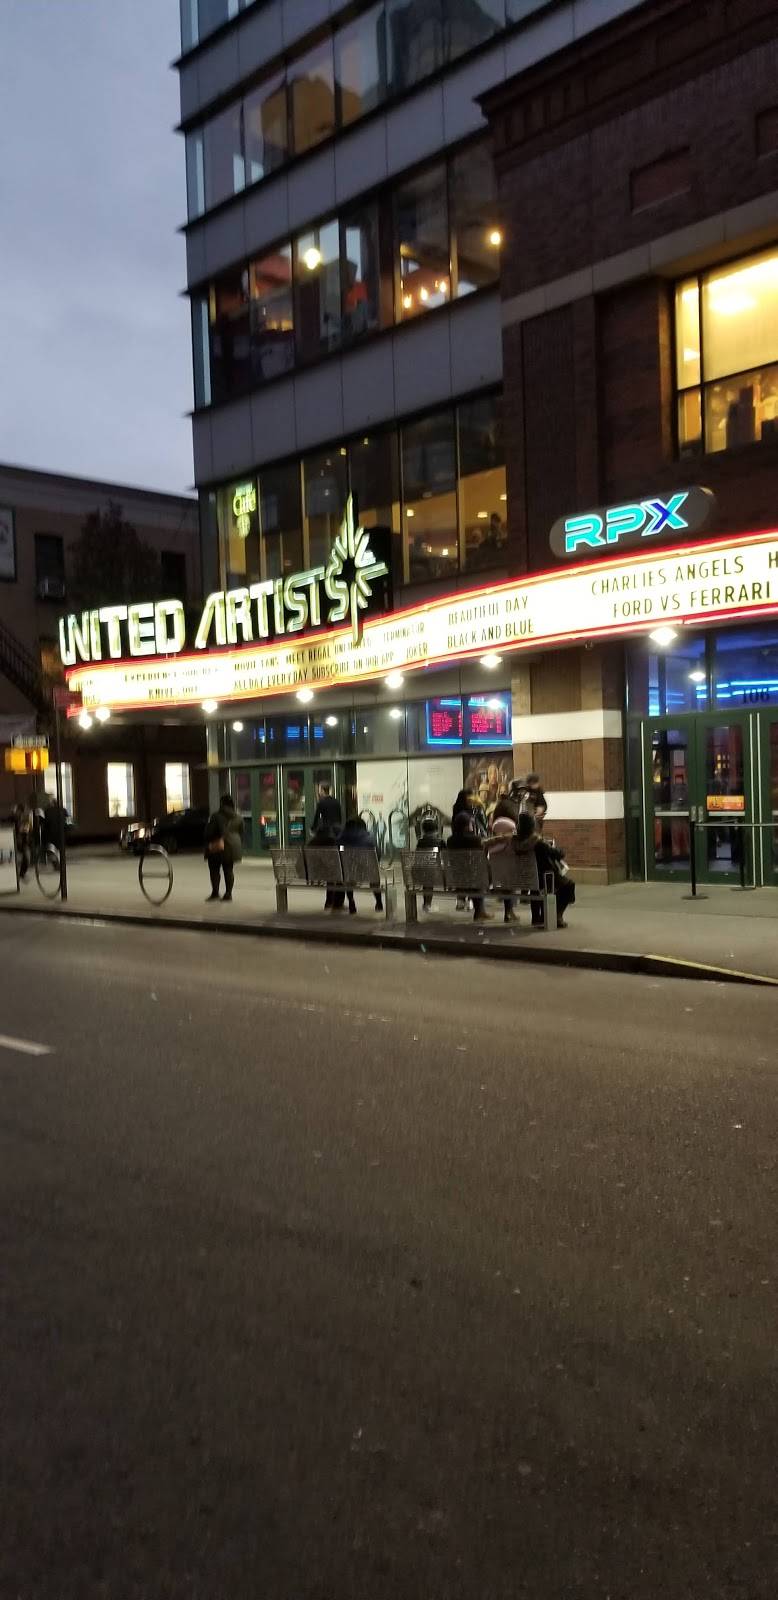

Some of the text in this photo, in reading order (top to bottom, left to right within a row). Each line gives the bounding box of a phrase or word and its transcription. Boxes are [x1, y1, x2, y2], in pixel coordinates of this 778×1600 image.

[564, 492, 689, 553] RPX
[591, 568, 667, 596] CHARLIES
[674, 556, 745, 583] ANGELS
[59, 550, 350, 666] UNITED ARTISTS
[447, 595, 528, 626] BEAUTIFUL DAY
[612, 580, 771, 619] FORD VS FERRARI
[447, 619, 534, 649] BLACK AND BLUE
[286, 649, 305, 664] MEET
[308, 644, 330, 663] REGAL
[406, 642, 428, 660] JOKER
[311, 660, 348, 680] SUBSCRIBE
